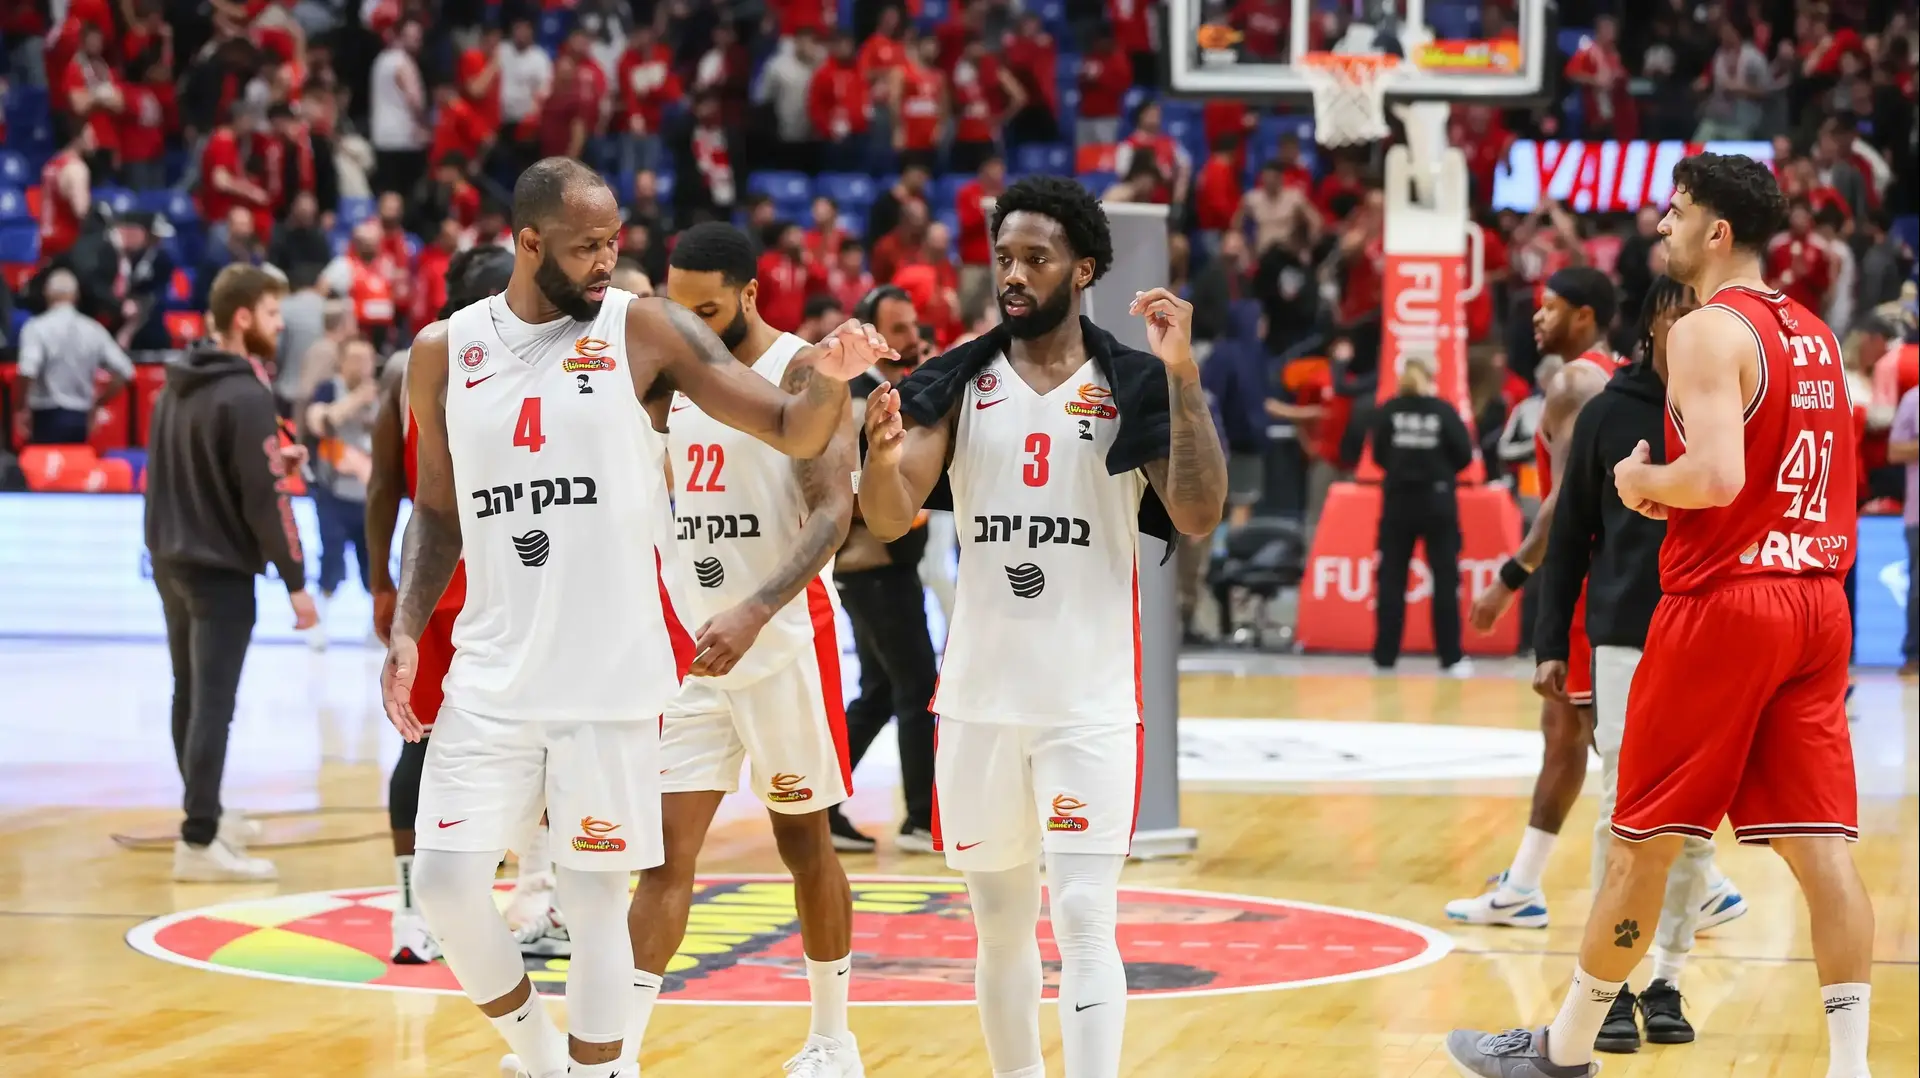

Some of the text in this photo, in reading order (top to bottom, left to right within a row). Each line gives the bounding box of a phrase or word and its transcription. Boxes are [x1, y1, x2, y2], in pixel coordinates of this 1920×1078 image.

[568, 361, 600, 370] Winner
[1798, 381, 1817, 395] בית
[513, 396, 546, 453] 4
[1070, 404, 1101, 415] Winner
[686, 443, 726, 492] 22
[1023, 432, 1051, 488] 3
[1776, 429, 1834, 522] 41
[472, 476, 598, 519] בנק יהב
[706, 513, 761, 544] בנק
[974, 515, 1091, 549] בנק יהב
[577, 840, 609, 850] Winner
